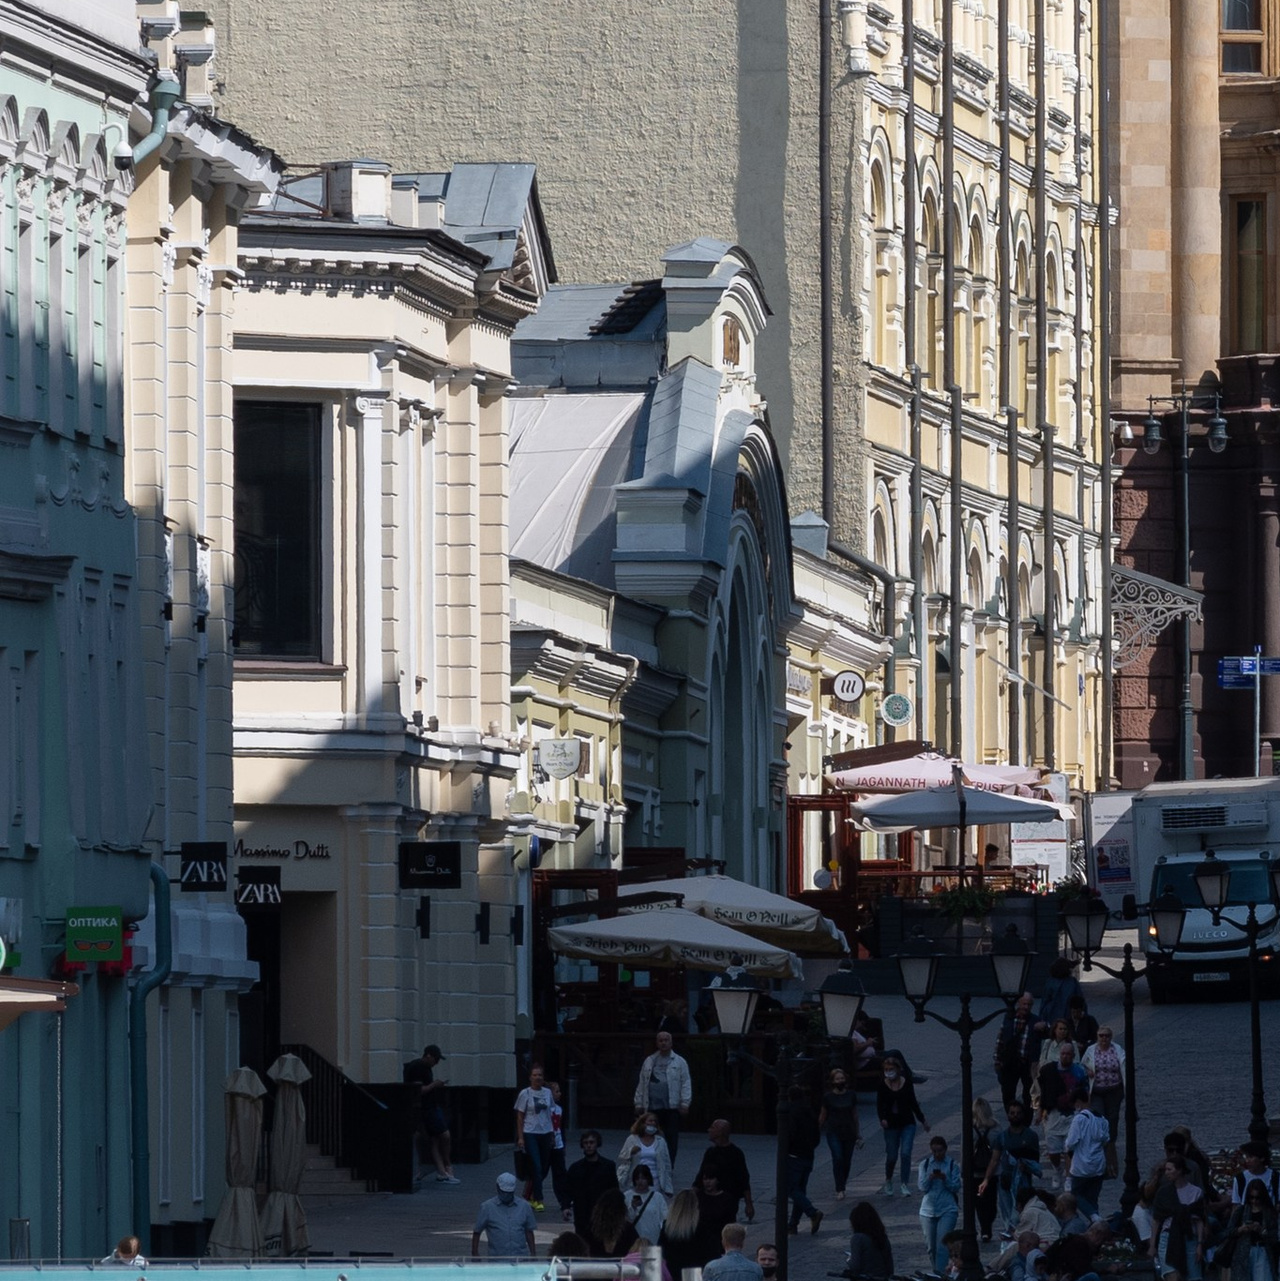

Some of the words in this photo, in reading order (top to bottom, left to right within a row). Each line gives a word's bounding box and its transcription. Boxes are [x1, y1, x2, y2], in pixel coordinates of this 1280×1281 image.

[855, 776, 926, 789] JAGANNATH
[293, 839, 331, 861] Dutti
[181, 861, 227, 882] ZARA
[238, 883, 281, 904] ZARA
[68, 917, 118, 928] ОПТИКА
[1193, 930, 1228, 939] IVECO
